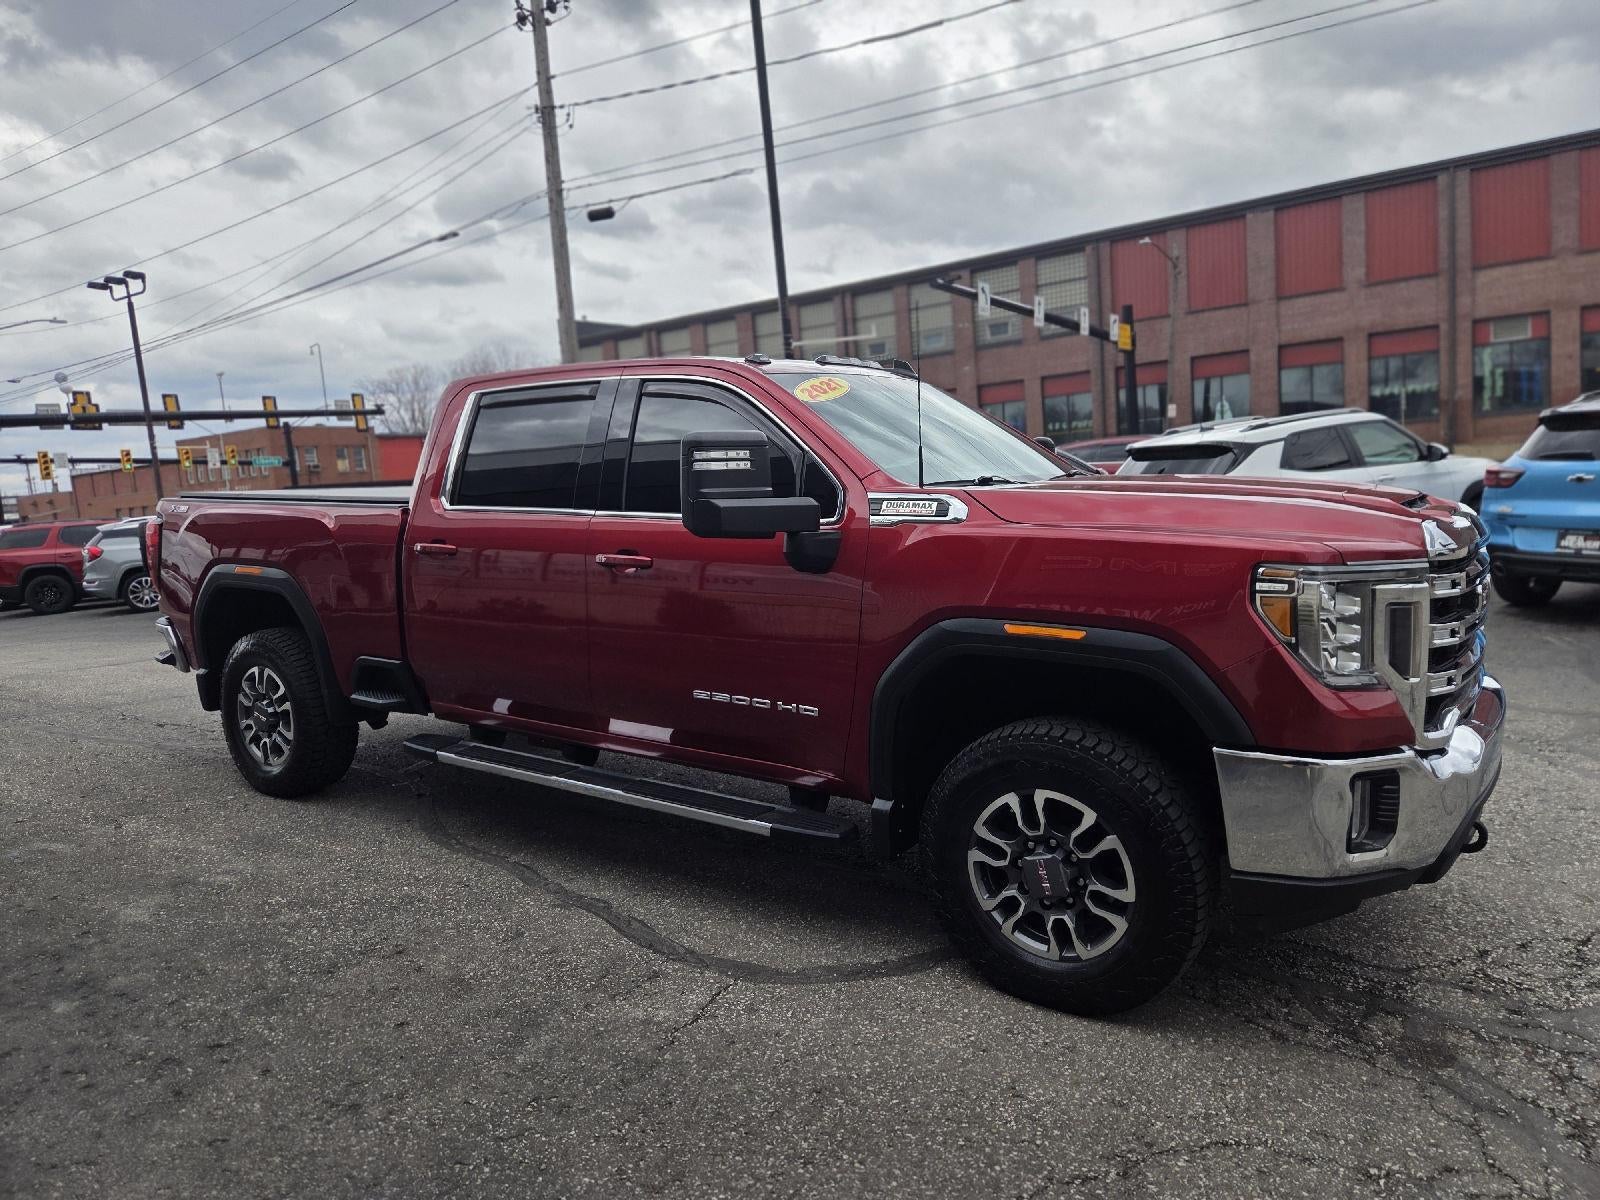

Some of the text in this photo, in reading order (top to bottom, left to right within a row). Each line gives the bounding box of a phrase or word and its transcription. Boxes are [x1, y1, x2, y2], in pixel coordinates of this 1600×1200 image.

[800, 378, 845, 399] 2021
[885, 501, 934, 510] DURAMAX
[777, 701, 819, 717] HD
